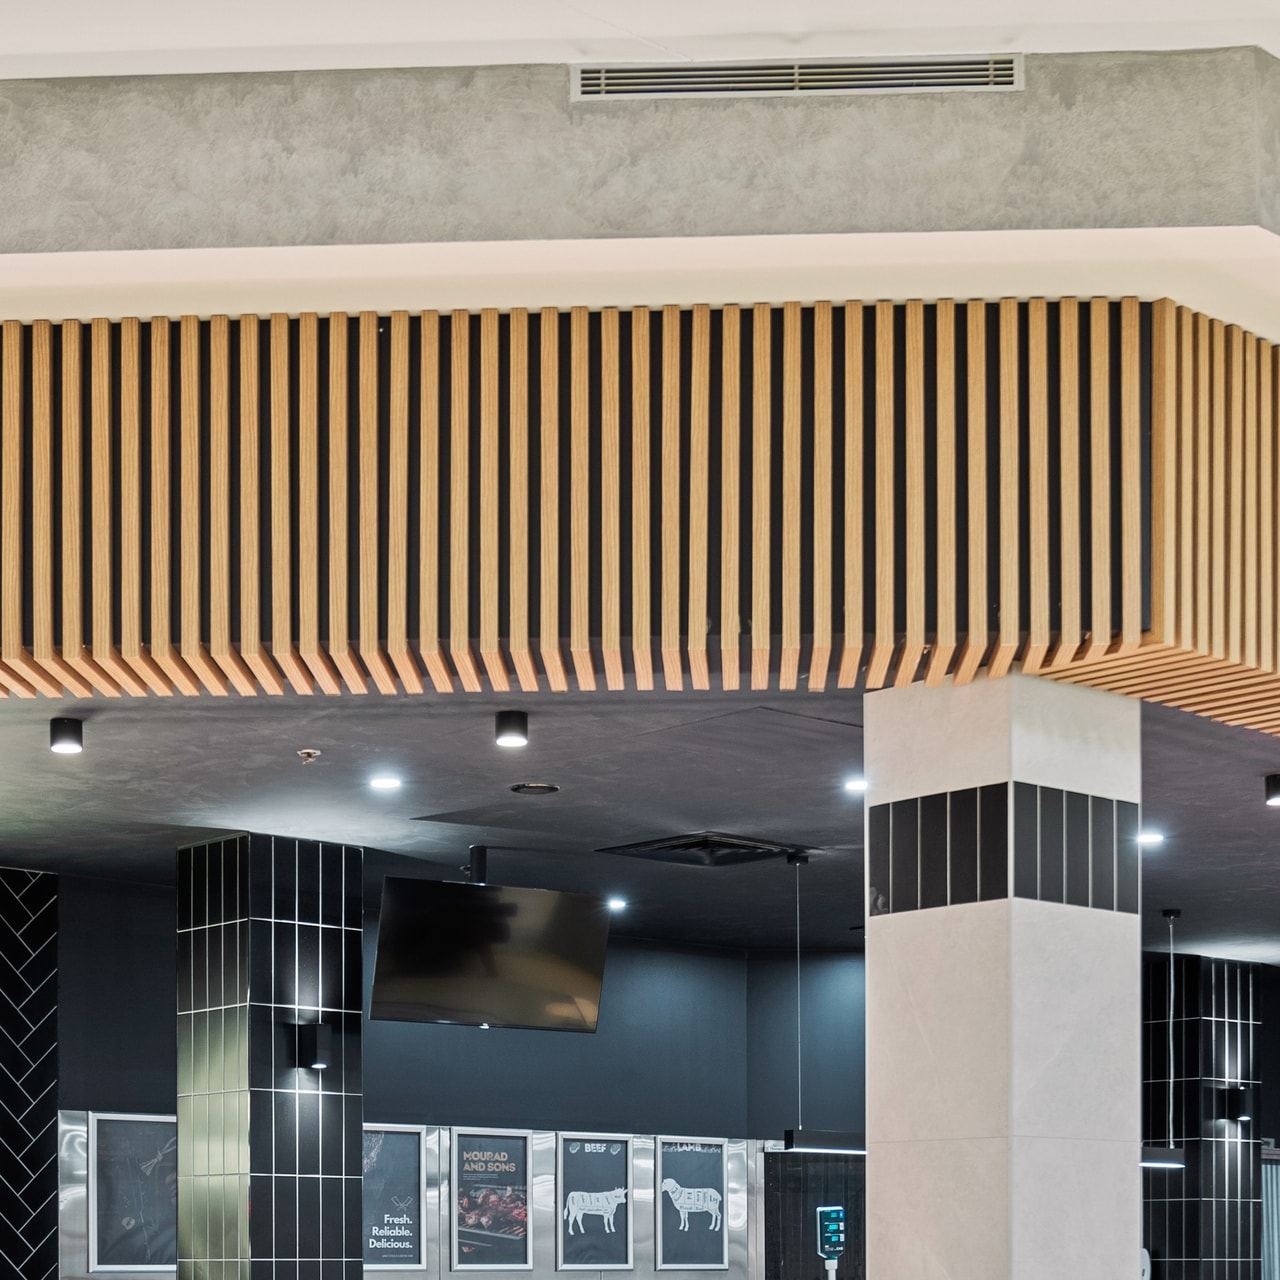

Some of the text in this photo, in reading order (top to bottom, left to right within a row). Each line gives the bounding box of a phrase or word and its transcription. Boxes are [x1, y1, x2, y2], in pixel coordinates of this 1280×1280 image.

[584, 1143, 607, 1153] BEEF
[677, 1142, 702, 1152] LAMB
[463, 1151, 508, 1161] MOURAD
[463, 1162, 517, 1172] AND SONS
[384, 1213, 413, 1224] Fresh.
[372, 1226, 413, 1236] Reliable.
[369, 1238, 413, 1249] Delicious.
